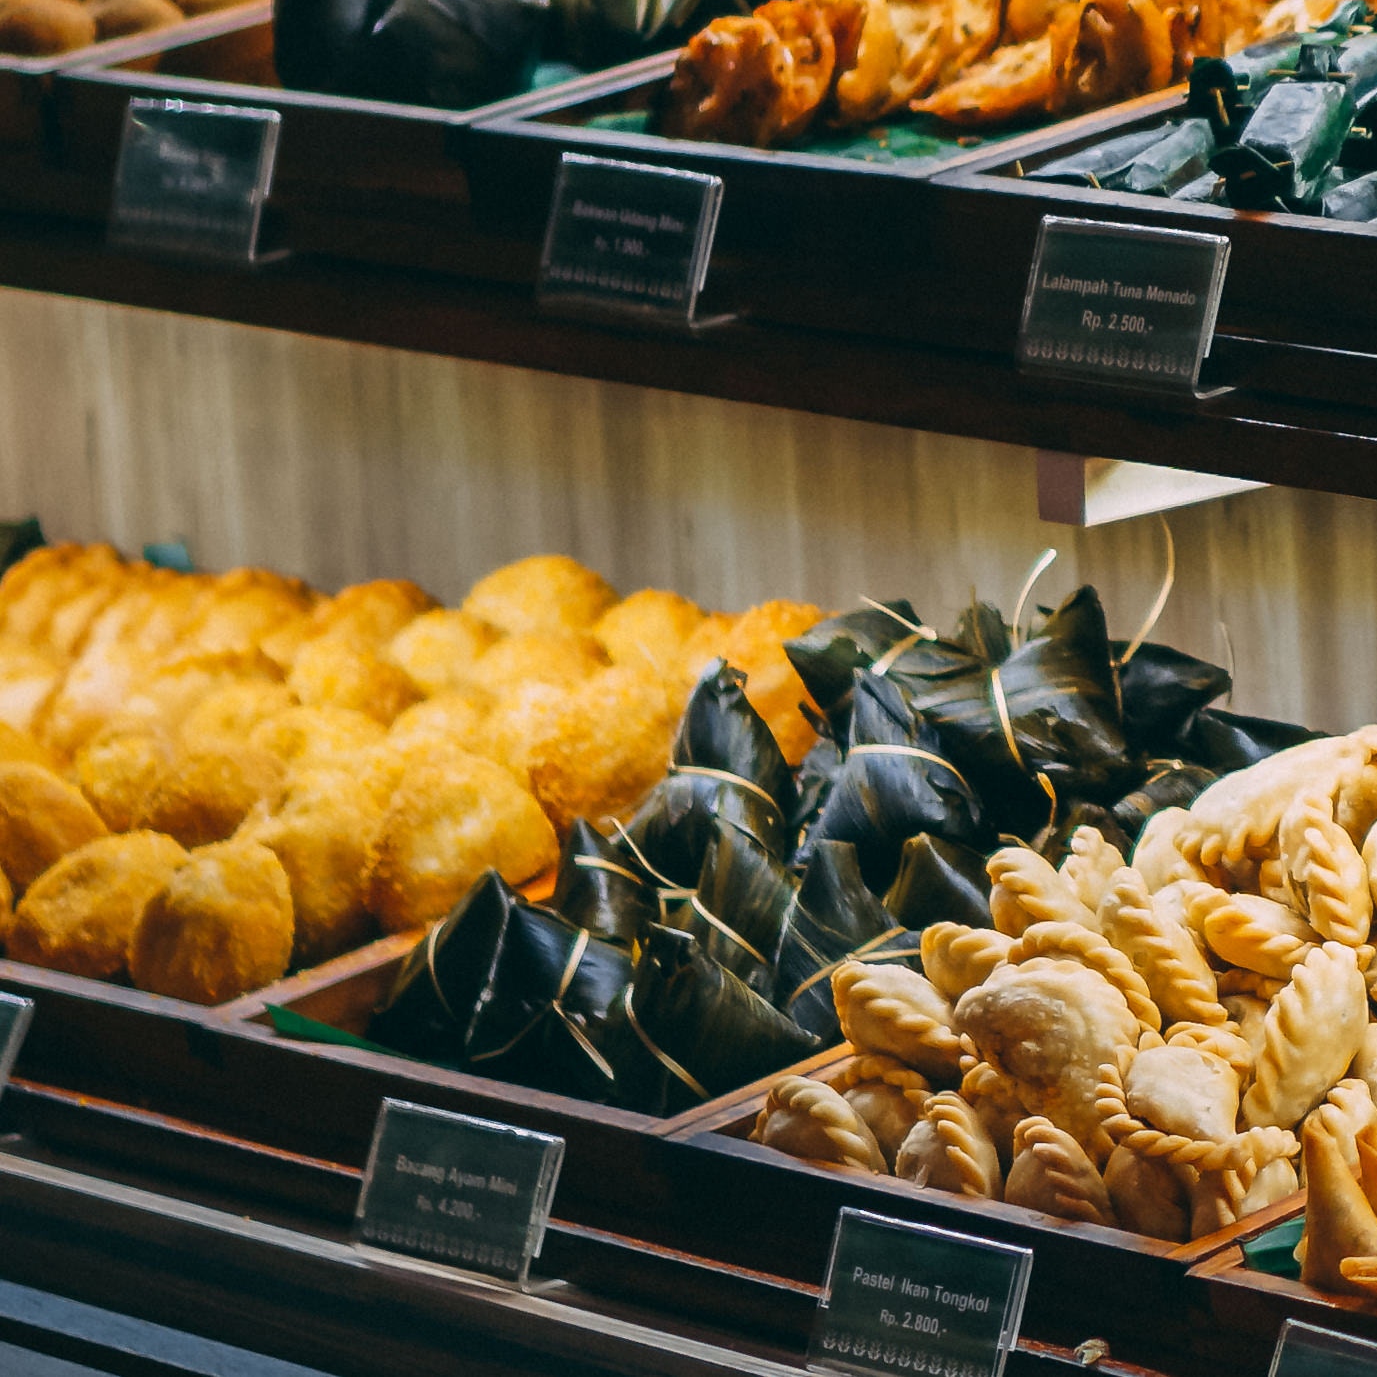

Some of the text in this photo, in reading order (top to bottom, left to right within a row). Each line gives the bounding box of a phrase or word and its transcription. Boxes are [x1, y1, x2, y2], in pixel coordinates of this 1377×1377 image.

[1041, 272, 1196, 305] Lalampah Tuna Menado
[1081, 309, 1104, 332] Rp.
[852, 1265, 991, 1313] Pastel Ikan Tongkol
[879, 1308, 949, 1339] Rp. 2.800,-
